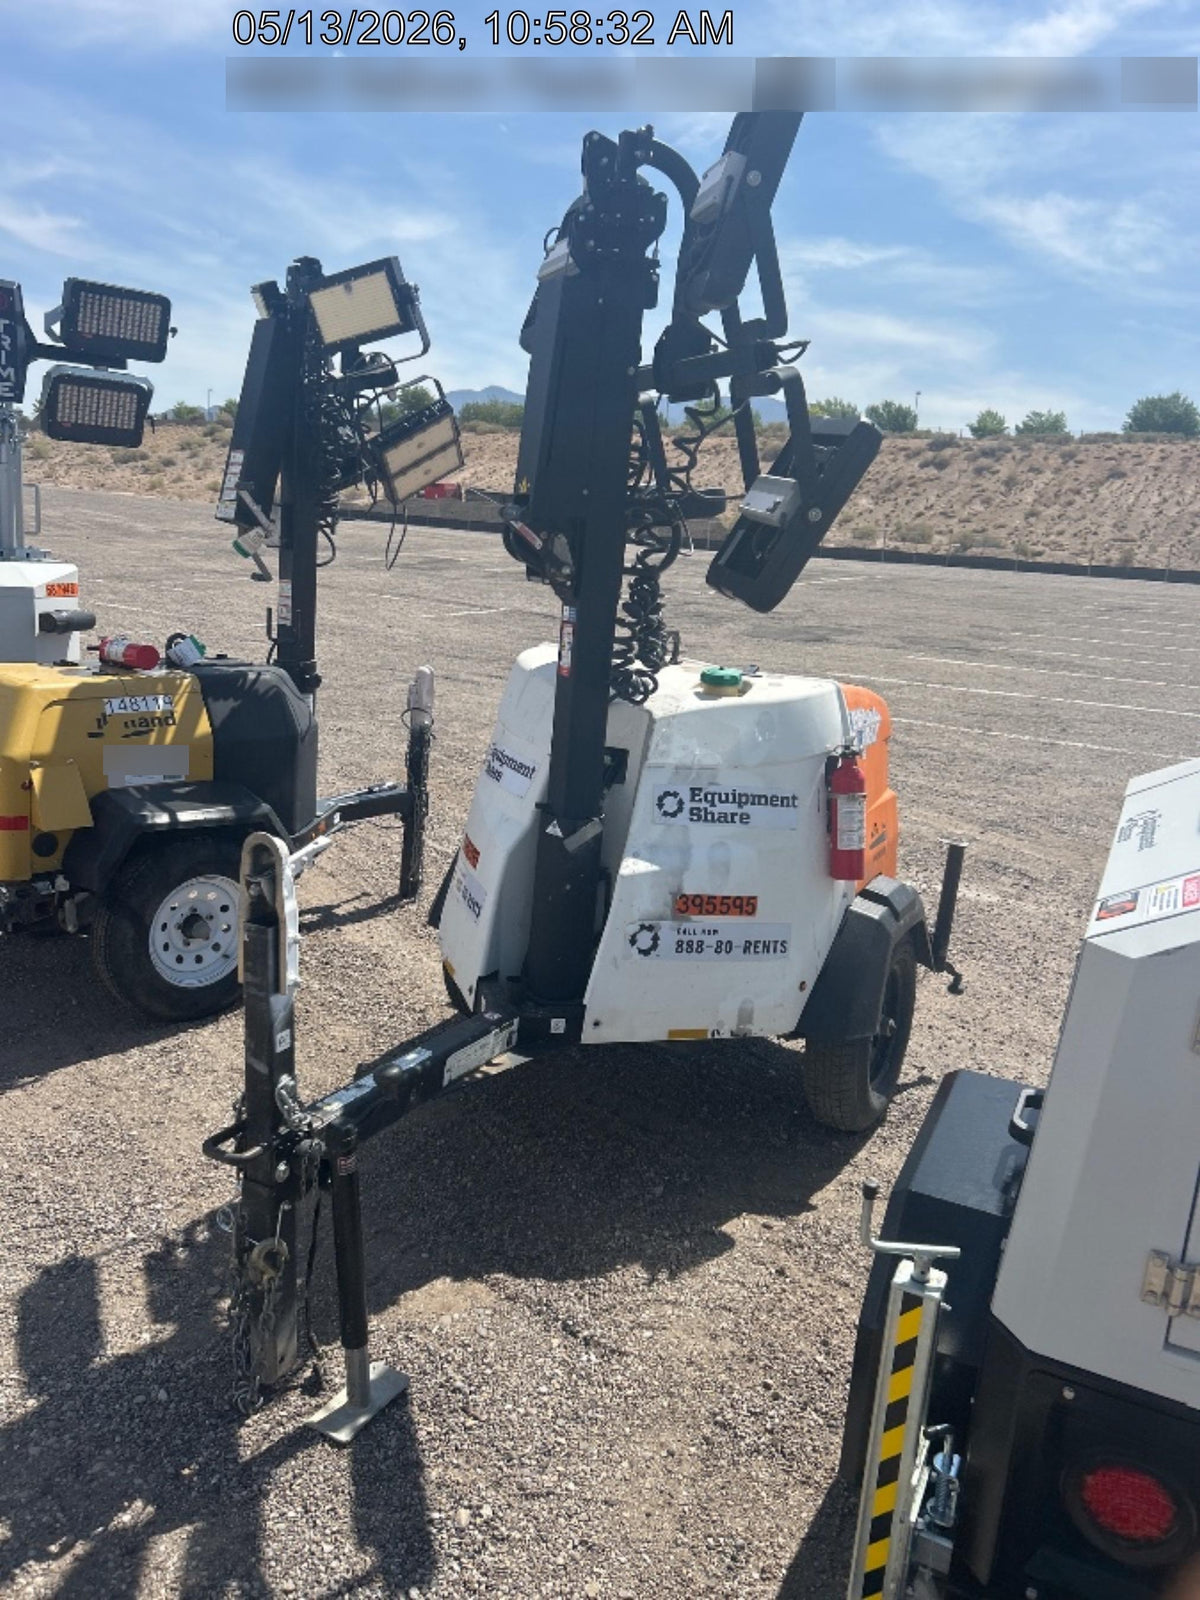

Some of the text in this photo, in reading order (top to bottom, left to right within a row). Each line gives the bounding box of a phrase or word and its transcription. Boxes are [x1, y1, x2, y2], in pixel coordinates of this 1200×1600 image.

[689, 786, 799, 809] Equipment
[688, 806, 751, 825] Share
[677, 894, 758, 917] 395595
[675, 939, 788, 956] 888-80-RENTS
